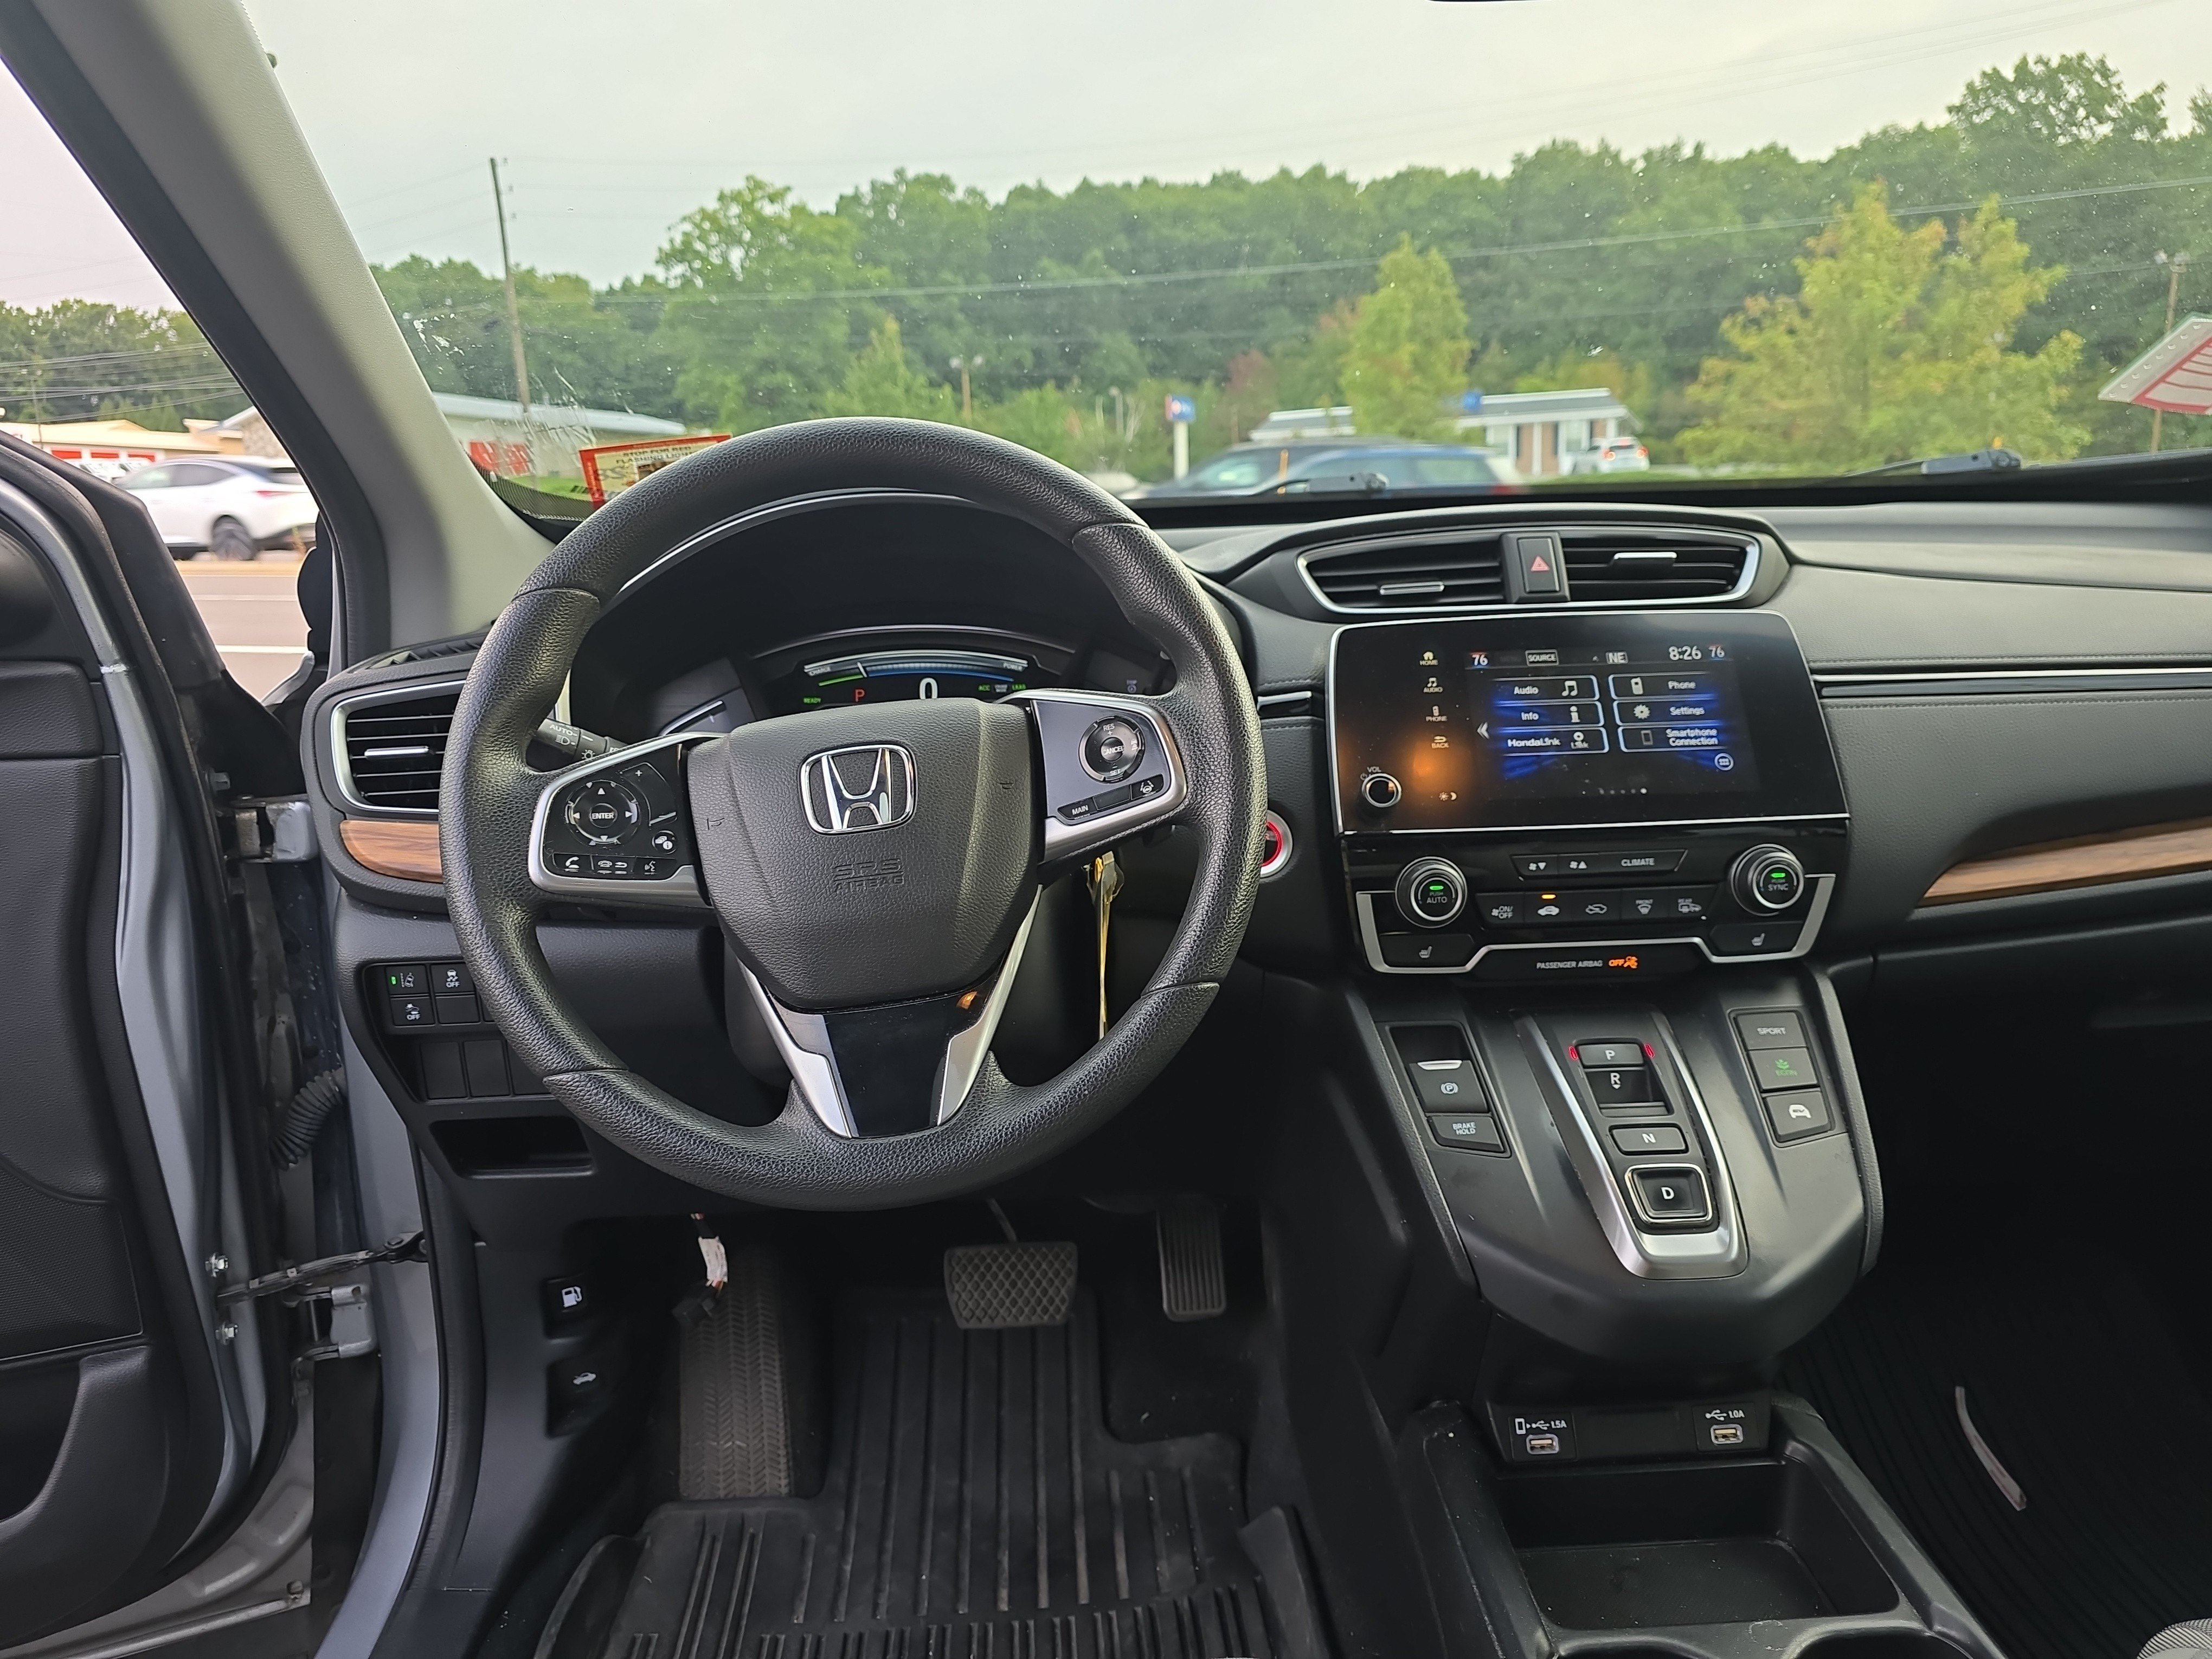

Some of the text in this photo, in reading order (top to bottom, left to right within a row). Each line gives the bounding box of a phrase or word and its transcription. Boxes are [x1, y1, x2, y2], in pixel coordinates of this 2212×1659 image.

[1609, 652, 1625, 663] NE
[1669, 645, 1725, 660] 8:26 76
[1472, 654, 1488, 666] 76
[1528, 654, 1557, 662] SOURCE
[919, 677, 938, 699] 0
[1668, 680, 1696, 690] Phone
[854, 689, 865, 702] P
[1514, 686, 1539, 695] Audio
[1521, 711, 1539, 721] Info
[1669, 706, 1705, 716] Settings
[549, 724, 574, 736] AUTO
[1666, 728, 1718, 737] Smartphone
[1507, 737, 1561, 747] HondaLink
[1669, 737, 1718, 747] Connection
[1103, 745, 1124, 755] CANCEL
[1072, 805, 1089, 815] MAIN
[1621, 858, 1655, 866] CLIMATE
[1767, 883, 1789, 891] SYNC
[1536, 961, 1577, 969] PASSENGER
[1578, 960, 1603, 968] AIRBAG
[1757, 1027, 1786, 1035] SPORT
[1605, 1050, 1615, 1060] P
[1610, 1072, 1621, 1084] R
[1452, 1122, 1476, 1130] BRAKE
[1642, 1133, 1656, 1143] N
[1661, 1187, 1675, 1200] D
